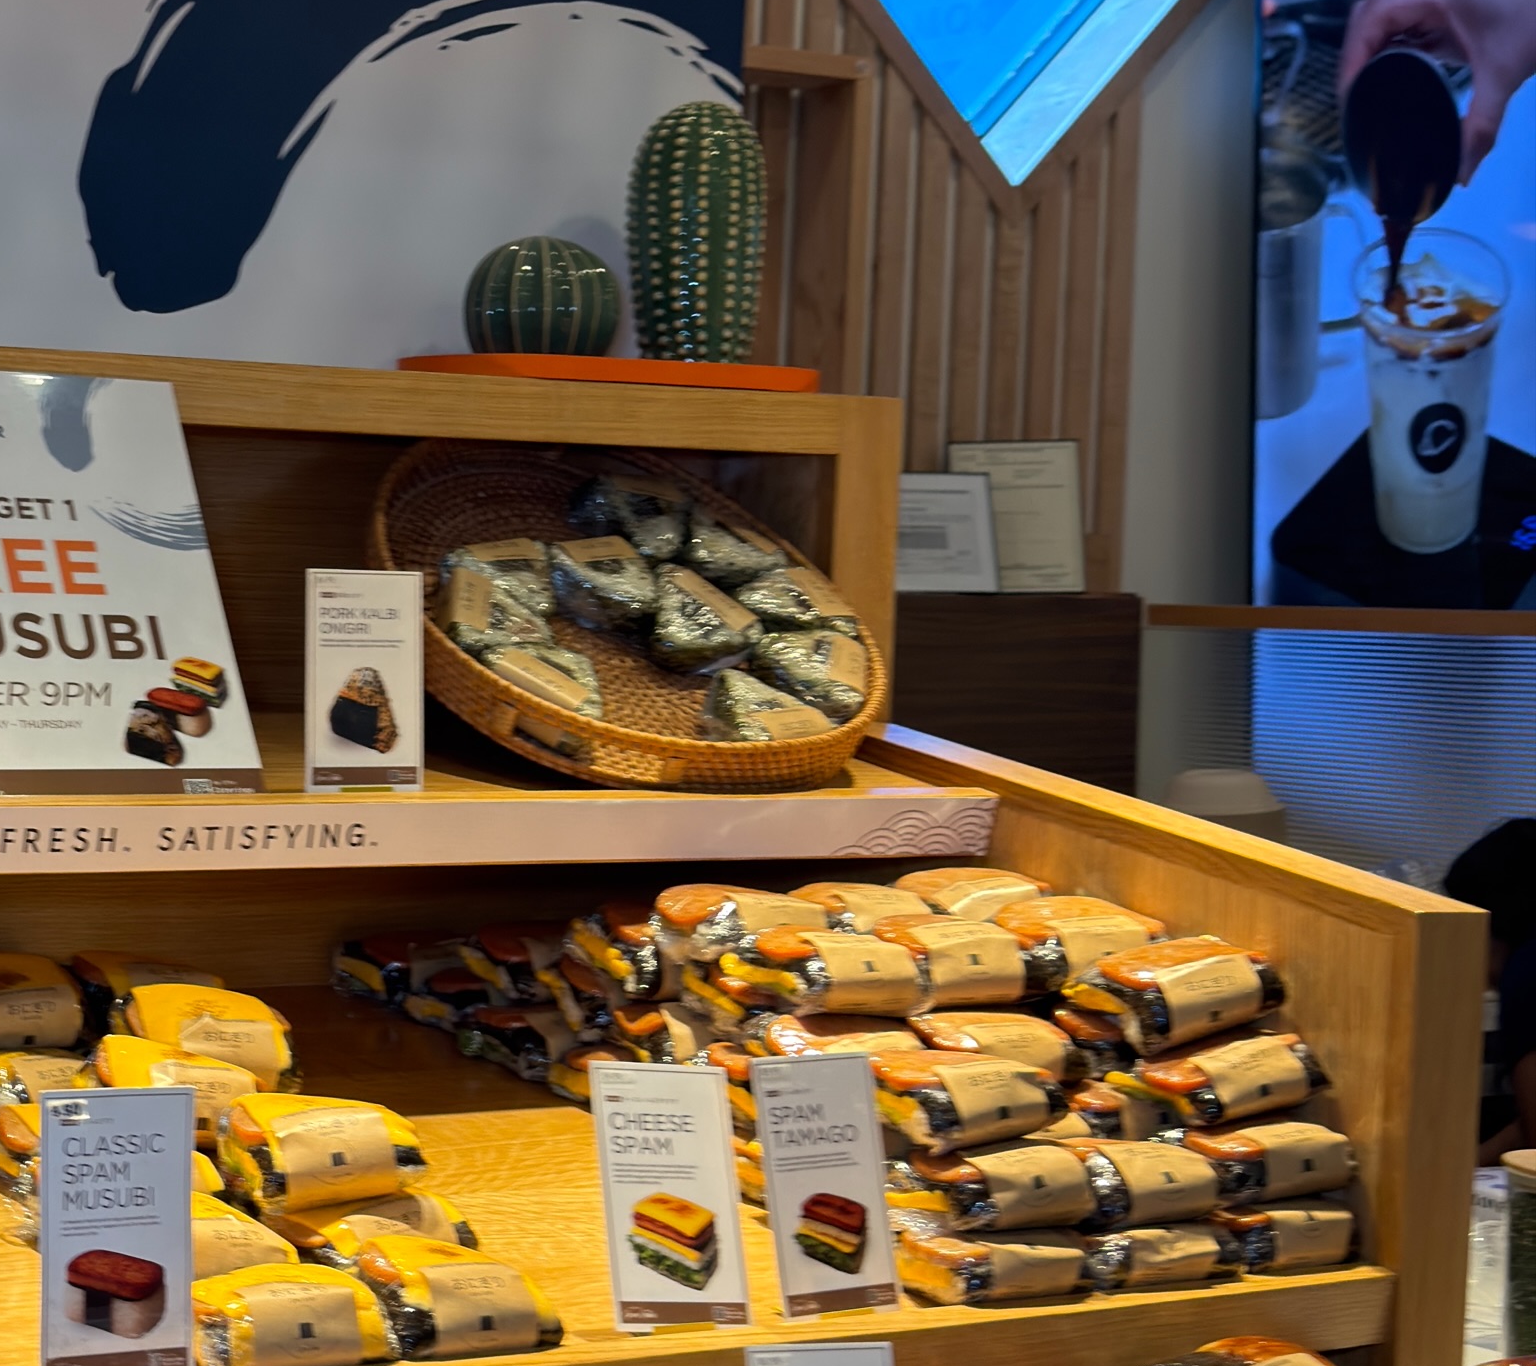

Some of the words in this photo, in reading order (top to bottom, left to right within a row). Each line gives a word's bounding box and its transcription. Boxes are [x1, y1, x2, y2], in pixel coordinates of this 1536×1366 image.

[62, 500, 78, 521] 1
[39, 681, 112, 707] 9PM
[0, 827, 132, 855] FRESH.
[156, 822, 378, 852] SATISFYING.
[608, 1112, 695, 1133] CHEESE
[768, 1103, 826, 1125] SPAM
[62, 1133, 166, 1157] CLASSIC
[610, 1136, 674, 1155] SPAM
[770, 1124, 859, 1148] TAMAGO
[62, 1161, 131, 1184] SPAM
[62, 1186, 155, 1211] MUSUBI
